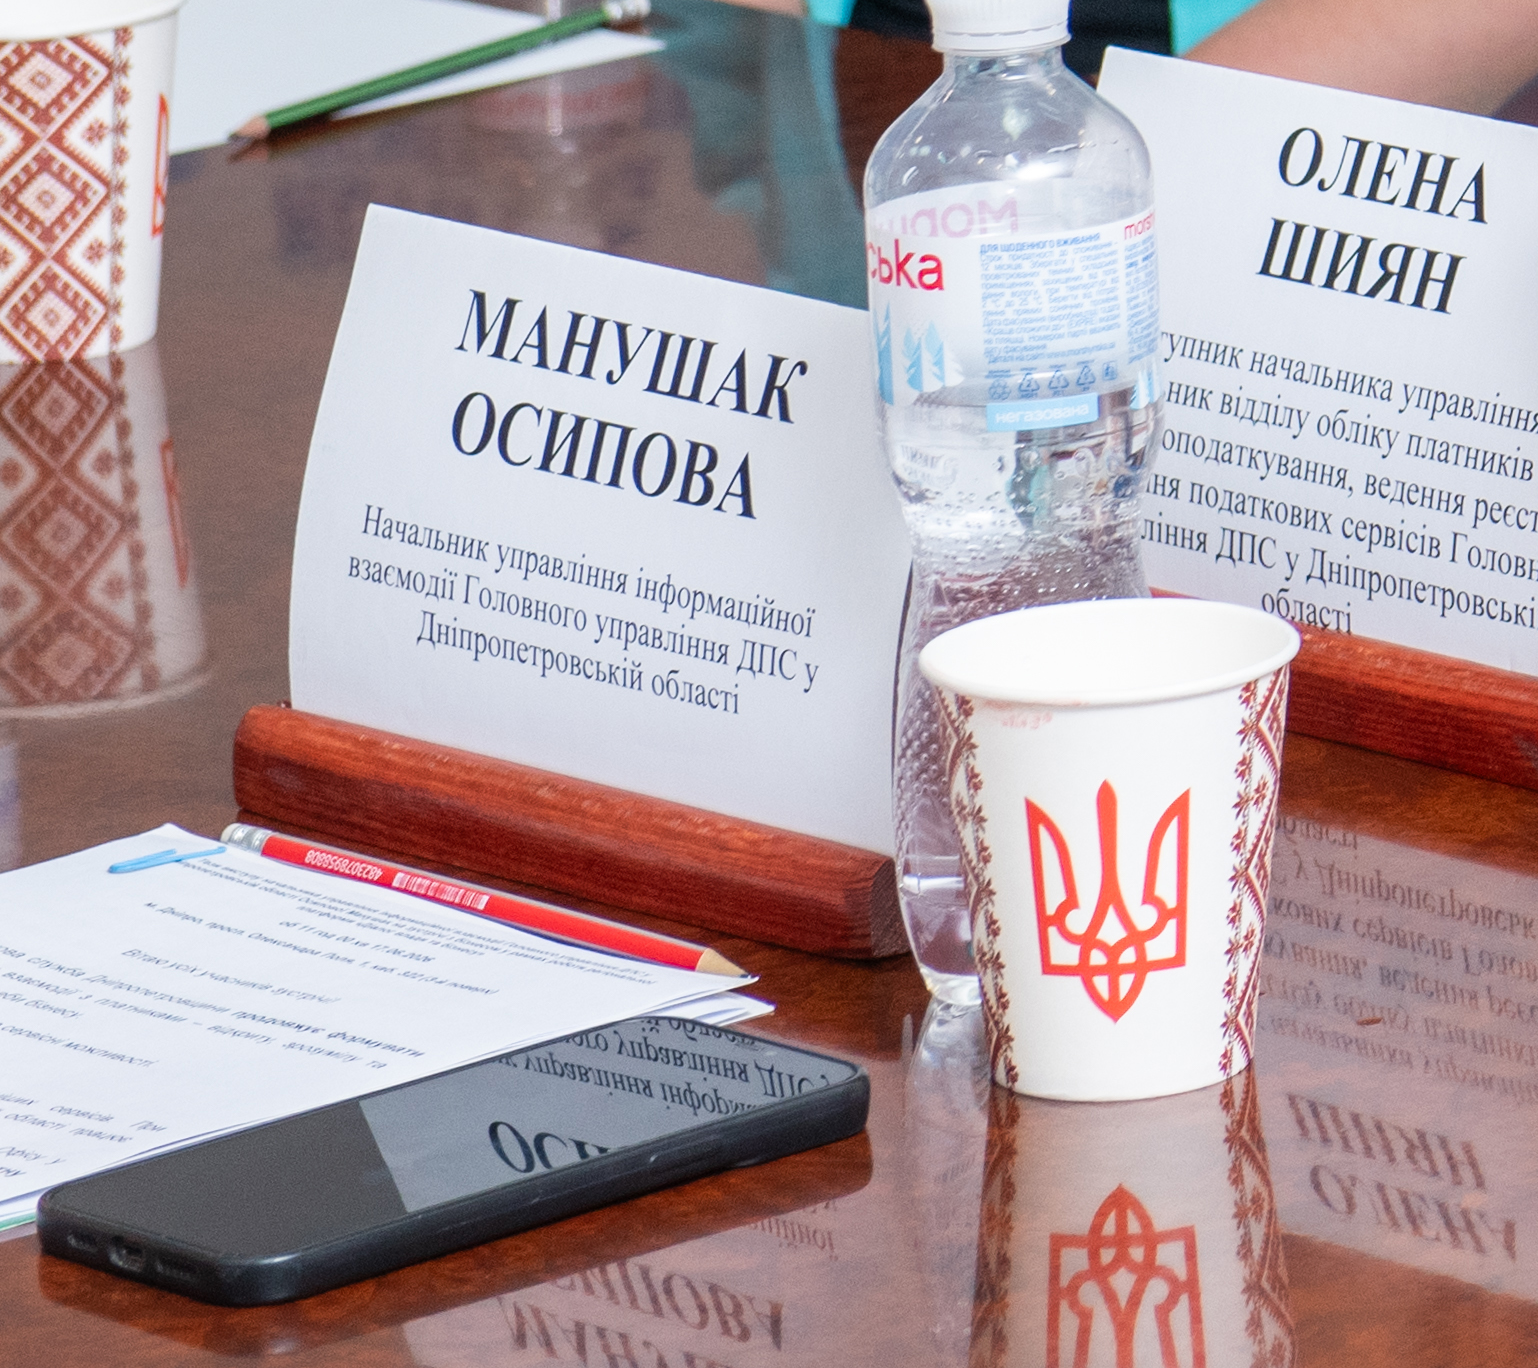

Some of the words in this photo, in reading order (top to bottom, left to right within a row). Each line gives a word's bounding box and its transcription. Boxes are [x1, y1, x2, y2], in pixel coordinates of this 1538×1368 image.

[1277, 126, 1488, 225] ОЛЕНА
[1255, 216, 1466, 315] ШИЯН
[453, 288, 808, 425] МАНУШАК
[1247, 350, 1393, 403] начальника
[450, 390, 757, 520] ОСИПОВА
[994, 401, 1091, 425] негазована
[1217, 384, 1311, 440] відділу
[1315, 407, 1400, 460] обліку
[1404, 432, 1534, 482] платників
[1187, 480, 1333, 535] податкових
[1340, 515, 1441, 559] сервісів
[1362, 472, 1466, 517] ведення
[360, 503, 490, 562] Начальник
[493, 543, 629, 595] управління
[634, 566, 816, 638] інформаційної
[1213, 525, 1277, 570] ДПС
[1283, 550, 1300, 583] у
[347, 555, 458, 601] взаємодії
[462, 572, 588, 632] Головного
[592, 613, 730, 666] управління
[734, 638, 797, 681] ДПС
[802, 661, 819, 694] у
[1261, 589, 1353, 636] області
[415, 609, 644, 692] Дніпропетровській
[650, 668, 739, 715] області
